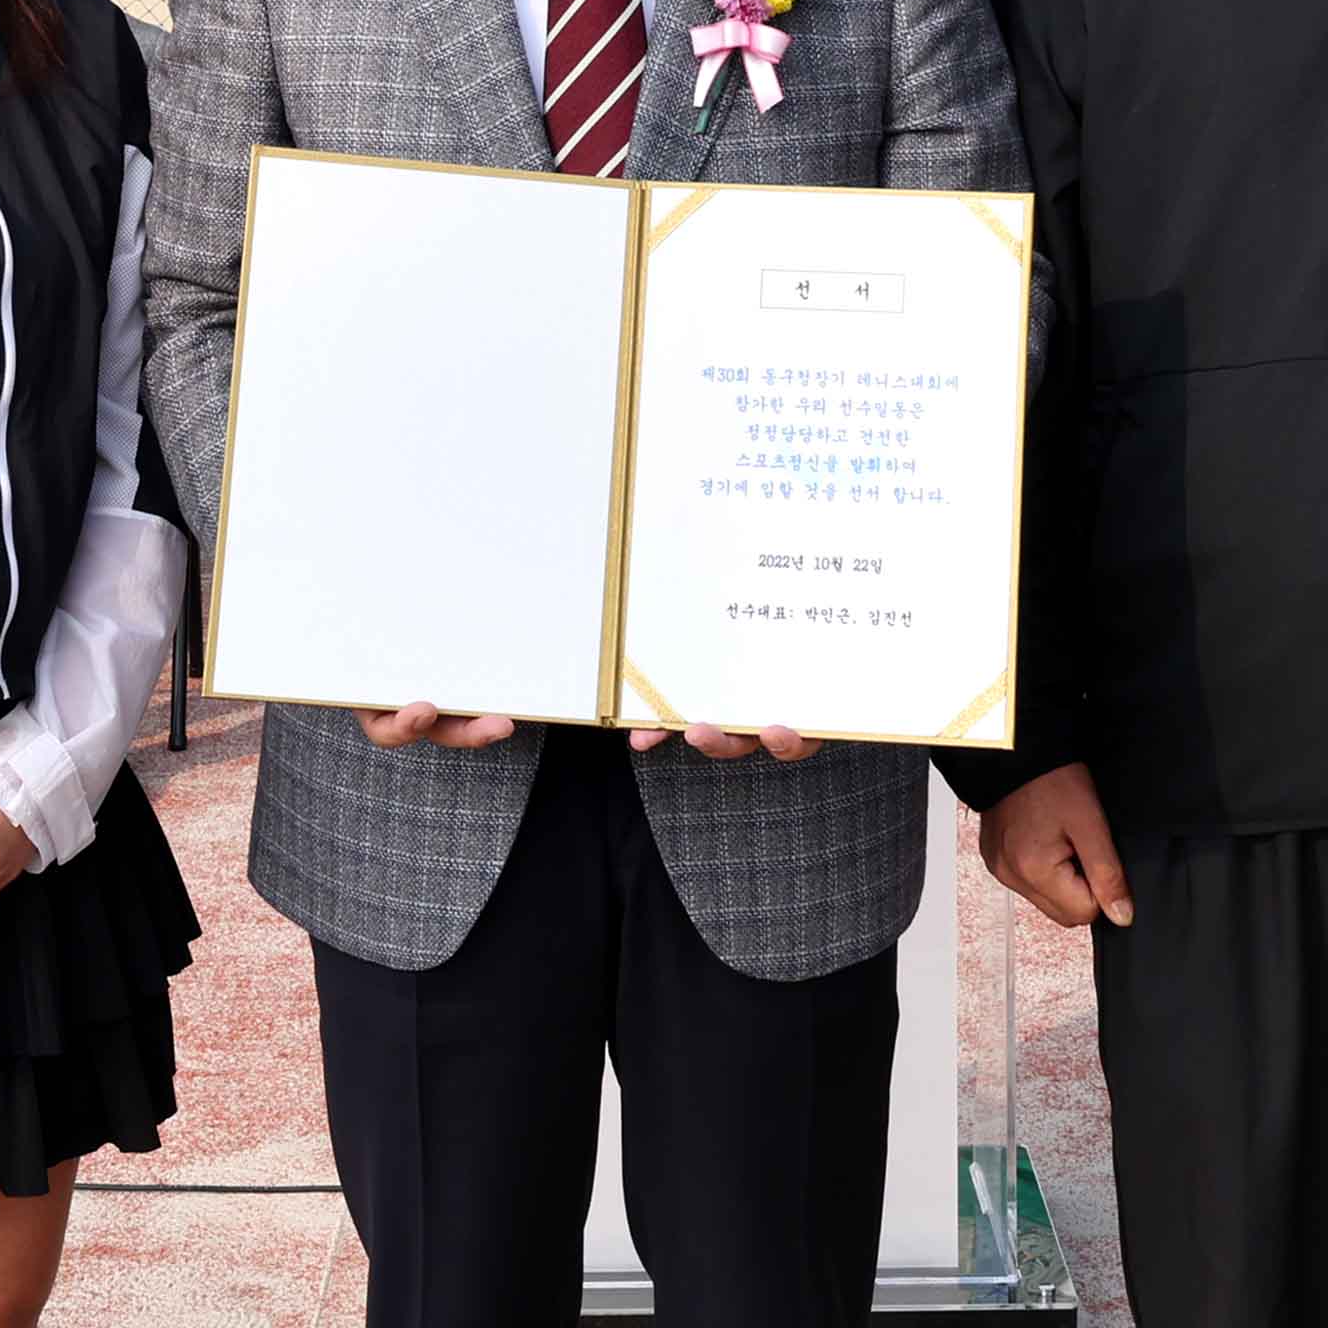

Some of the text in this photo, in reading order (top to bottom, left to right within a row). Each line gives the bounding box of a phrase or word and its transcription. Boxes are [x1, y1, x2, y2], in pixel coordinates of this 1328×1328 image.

[701, 366, 750, 383] 제30회
[757, 553, 883, 575] 2022년 10월 22일
